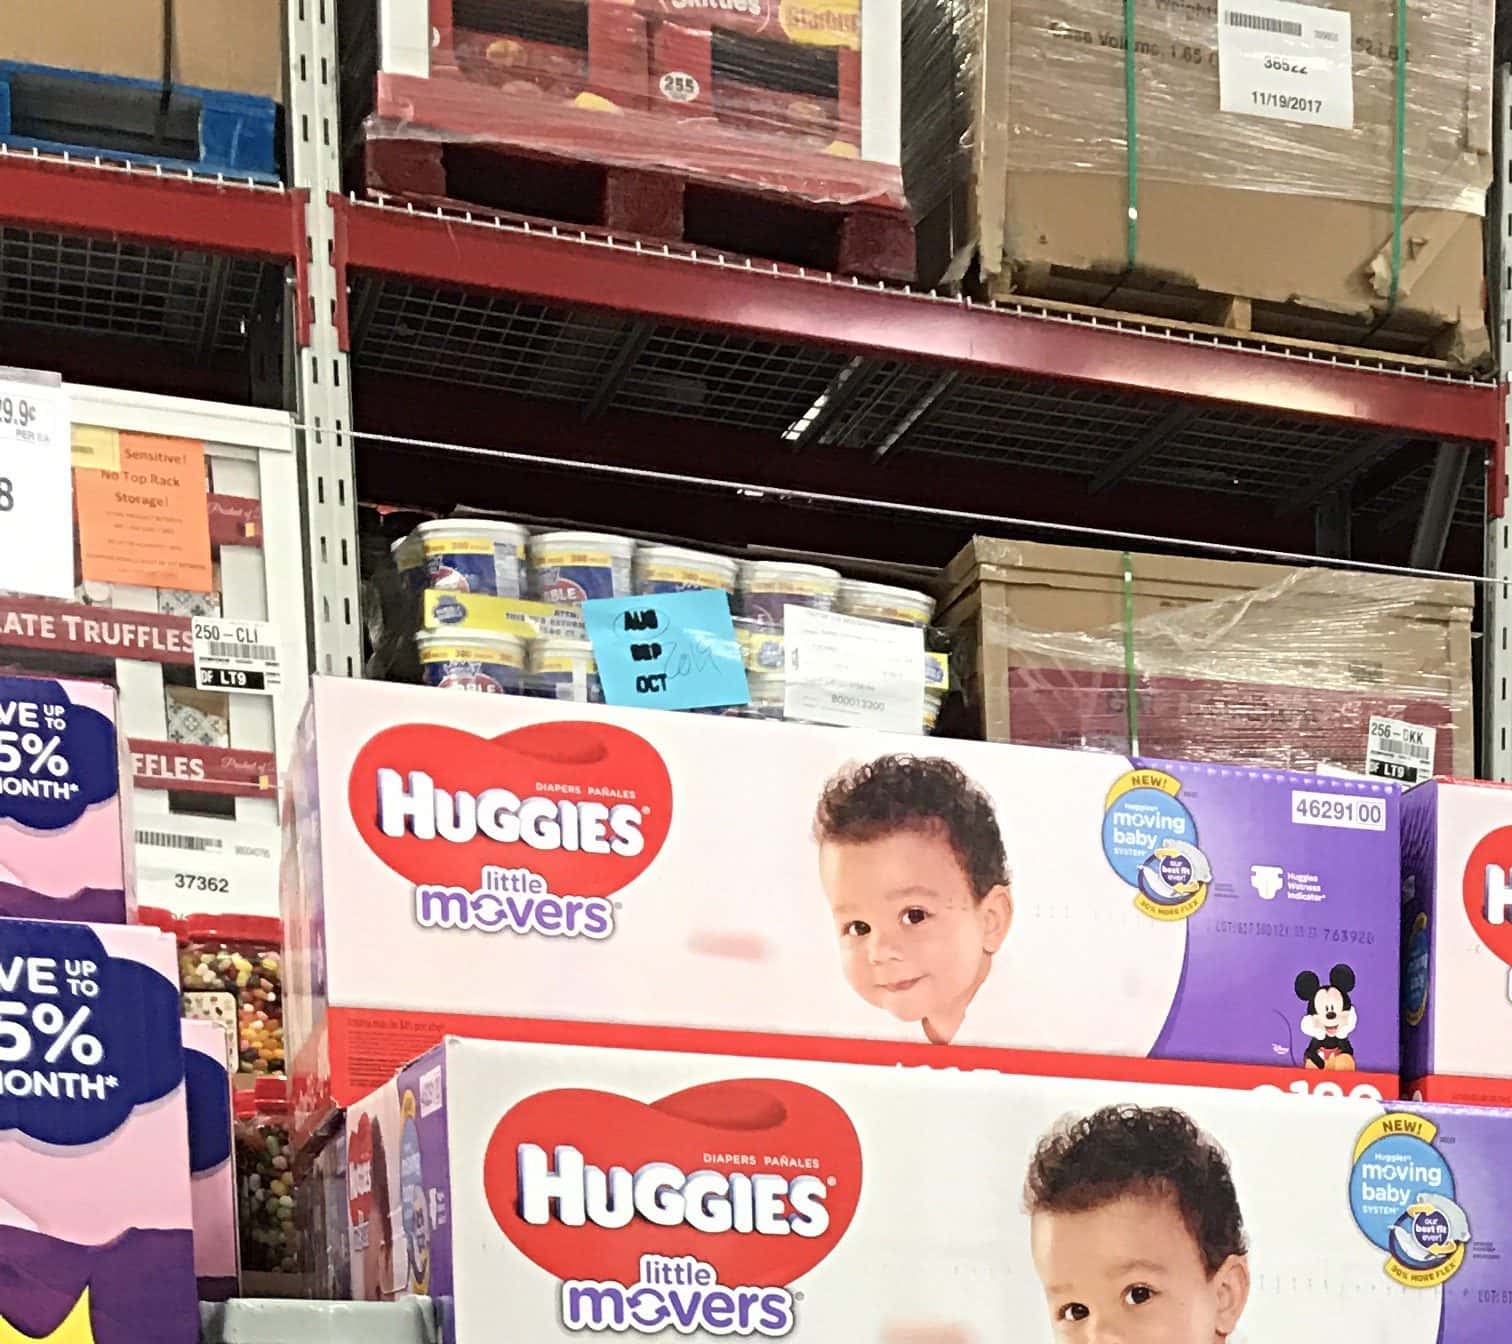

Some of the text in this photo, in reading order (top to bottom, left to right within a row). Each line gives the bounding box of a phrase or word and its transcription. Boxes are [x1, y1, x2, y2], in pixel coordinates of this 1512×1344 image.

[1251, 91, 1322, 113] 11/19/2017
[124, 448, 187, 465] Sensitive!
[101, 470, 181, 488] No Top Rack
[114, 491, 169, 508] Storage!
[63, 614, 194, 654] TRUFFLES
[1131, 773, 1169, 791] NEW!
[378, 767, 646, 858] HUGGIES
[1112, 808, 1187, 835] moving
[1112, 827, 1158, 852] baby
[174, 873, 229, 893] 37362
[486, 869, 543, 897] little
[420, 885, 609, 934] movers
[64, 956, 98, 978] UP
[66, 977, 100, 999] TO
[1381, 1117, 1424, 1136] NEW!
[703, 1151, 821, 1171] DIAPERS PAÑALES
[1361, 1162, 1443, 1188] moving
[516, 1142, 831, 1239] HUGGIES
[1361, 1181, 1412, 1207] baby
[645, 1257, 711, 1287] little
[568, 1284, 788, 1331] movers
